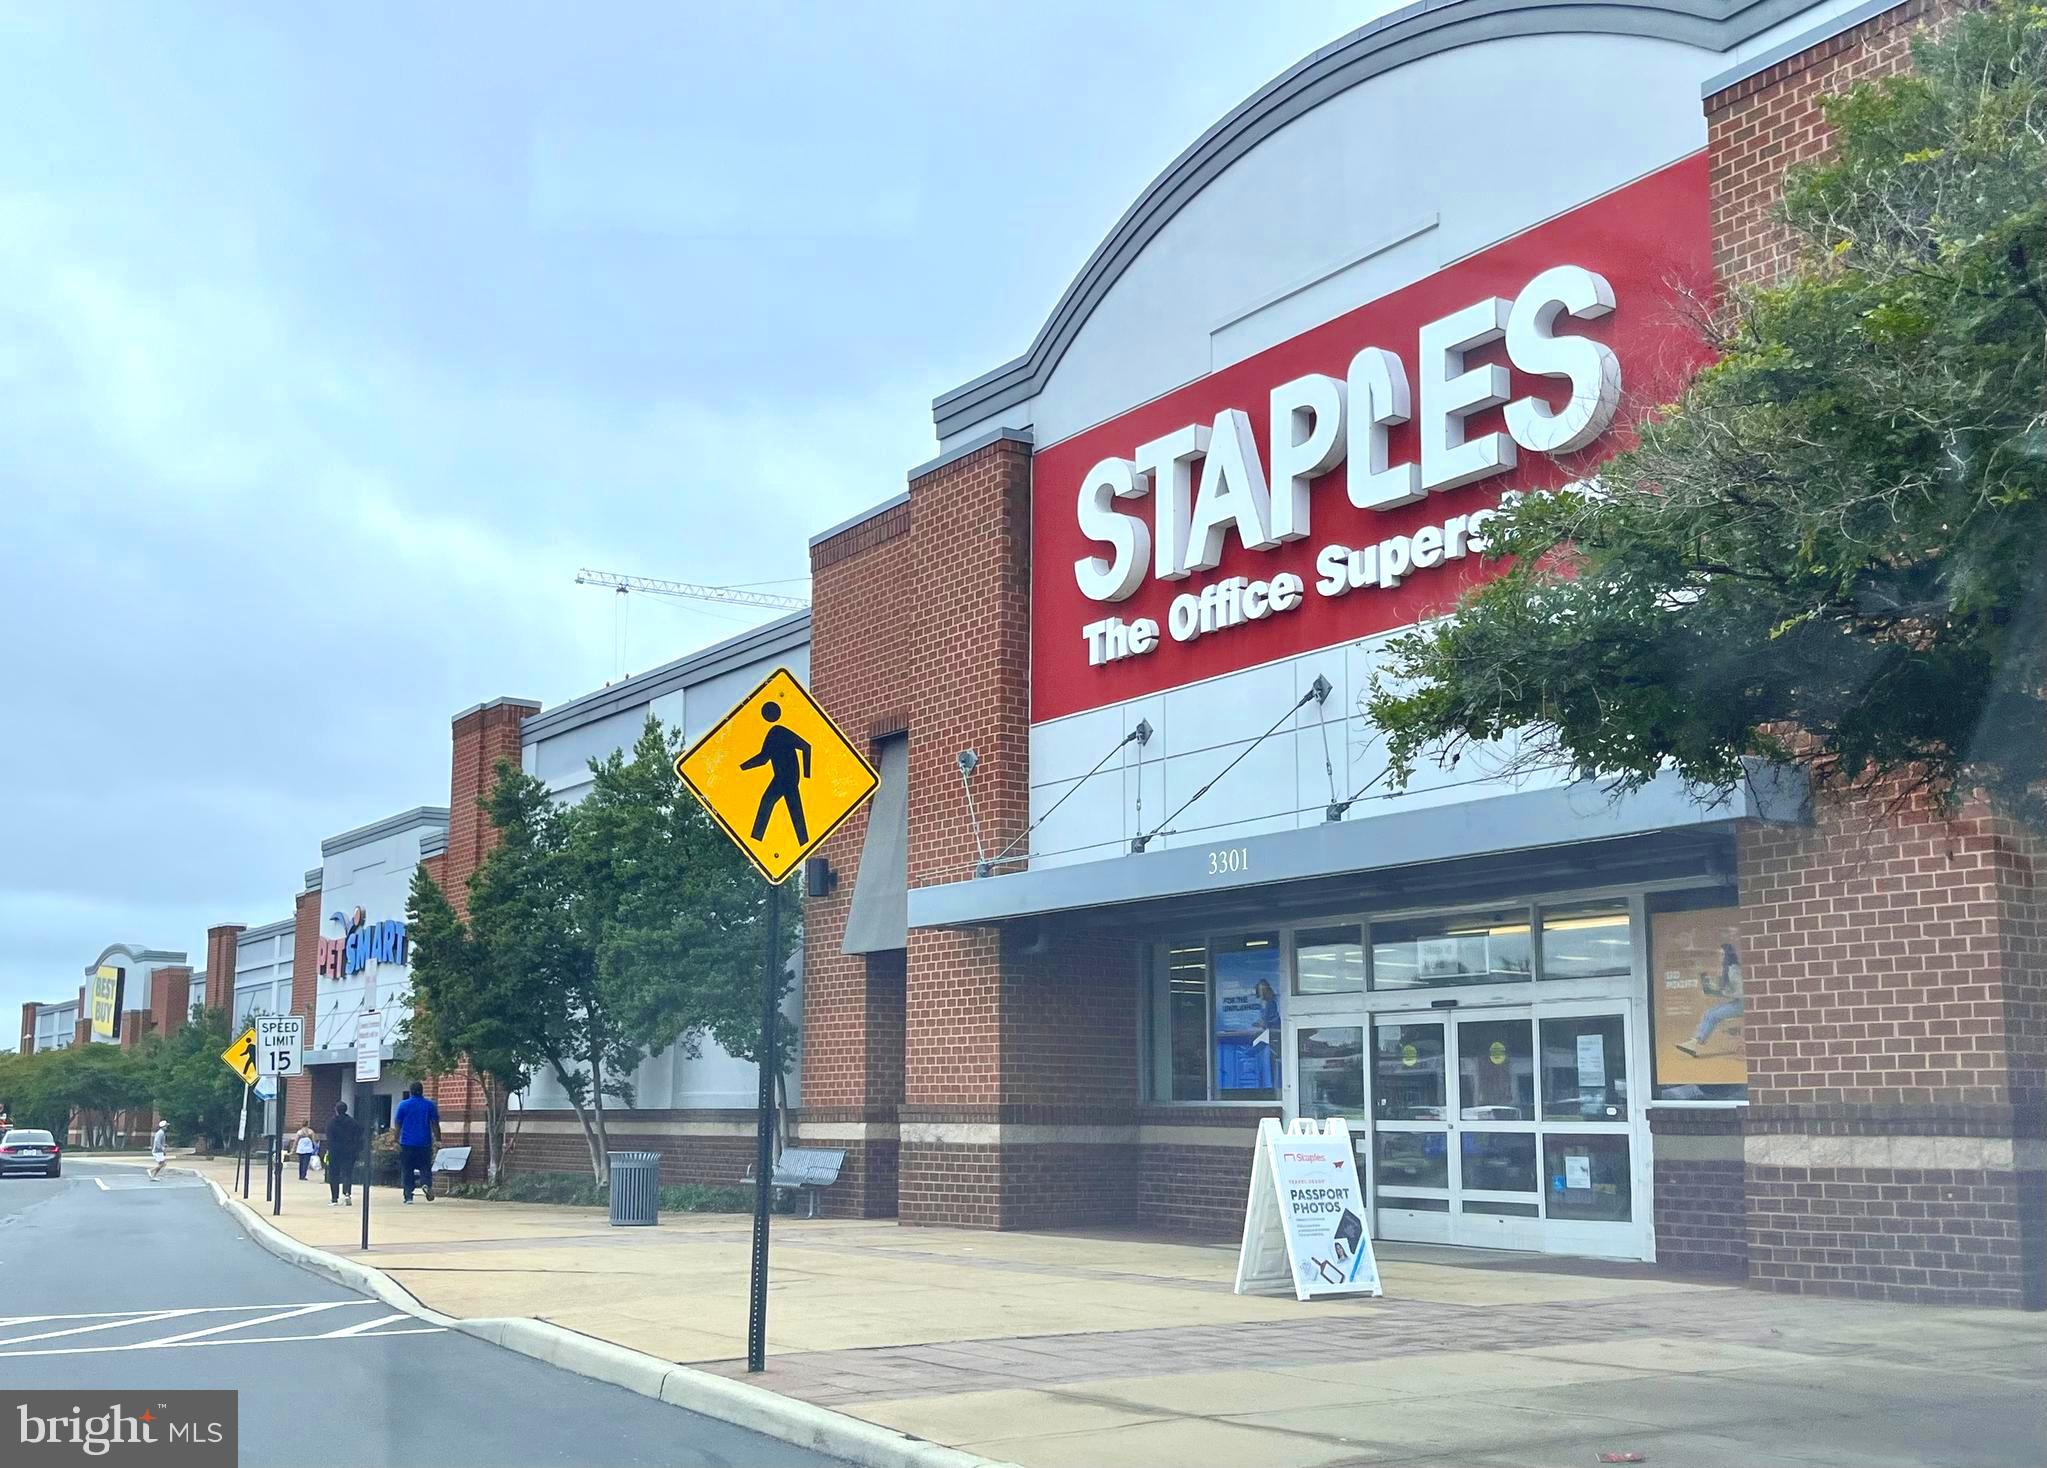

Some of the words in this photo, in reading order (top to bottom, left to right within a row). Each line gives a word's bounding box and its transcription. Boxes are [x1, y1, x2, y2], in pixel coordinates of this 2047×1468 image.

[1074, 264, 1621, 602] STAPLES
[1082, 616, 1160, 667] The
[1168, 572, 1304, 643] Office
[1315, 490, 1525, 597] Supers
[1208, 847, 1249, 875] 3301
[95, 976, 116, 1000] BEST
[95, 1001, 113, 1024] BUY
[262, 1022, 299, 1034] SPEED
[264, 1035, 296, 1047] LIMIT
[269, 1050, 291, 1071] 15
[1296, 1153, 1327, 1164] Staples
[1290, 1188, 1349, 1201] PASSPORT
[1292, 1201, 1341, 1214] PHOTOS
